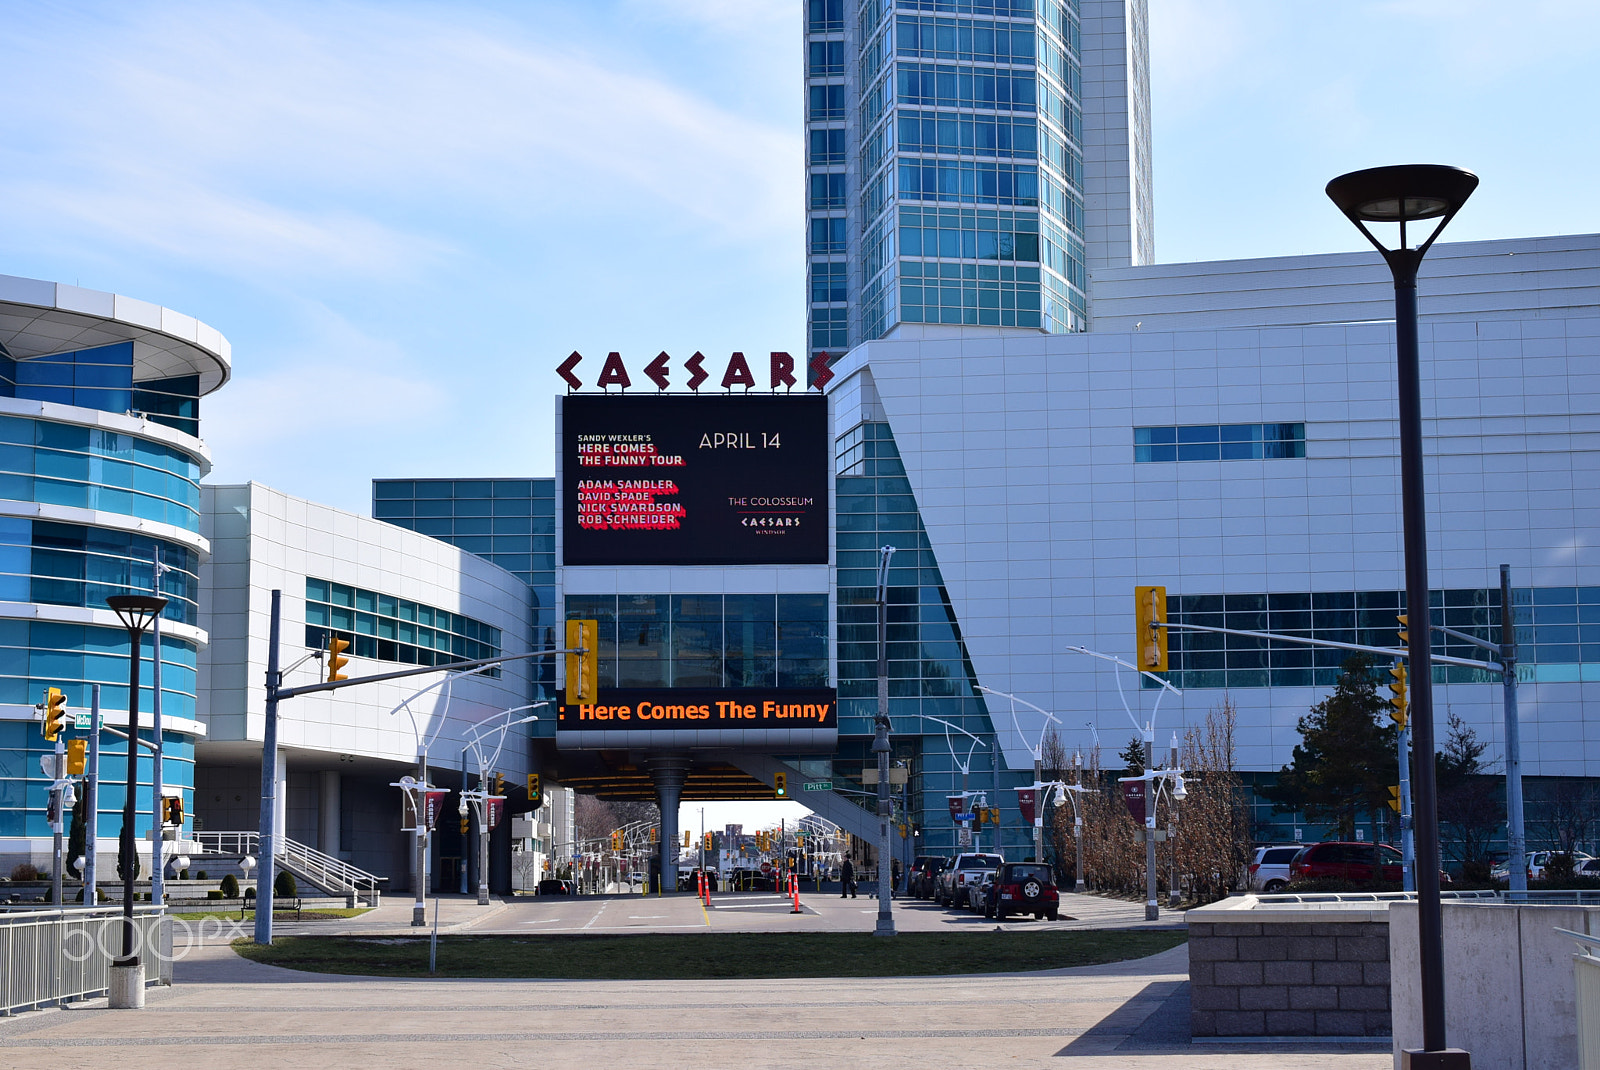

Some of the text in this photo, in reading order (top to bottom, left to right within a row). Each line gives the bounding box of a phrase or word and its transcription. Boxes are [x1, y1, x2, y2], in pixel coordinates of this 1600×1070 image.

[555, 350, 836, 391] CAESARS
[578, 434, 652, 442] SANDY WEXLER'S
[699, 432, 781, 449] APRIL 14
[578, 443, 655, 453] HERE COMES
[578, 455, 683, 465] THE FUNNY TOUR
[578, 480, 674, 489] ADAM SANDLER
[578, 492, 649, 501] DAVID SPADE
[728, 497, 813, 506] THE COLOSSEUM
[578, 503, 681, 512] NICK SWARDSON
[578, 515, 675, 524] ROB SCHNEIDER
[741, 517, 800, 527] CAESARS
[579, 702, 631, 720] Here
[637, 702, 710, 720] Comes
[716, 701, 756, 719] The
[763, 701, 829, 722] Funny
